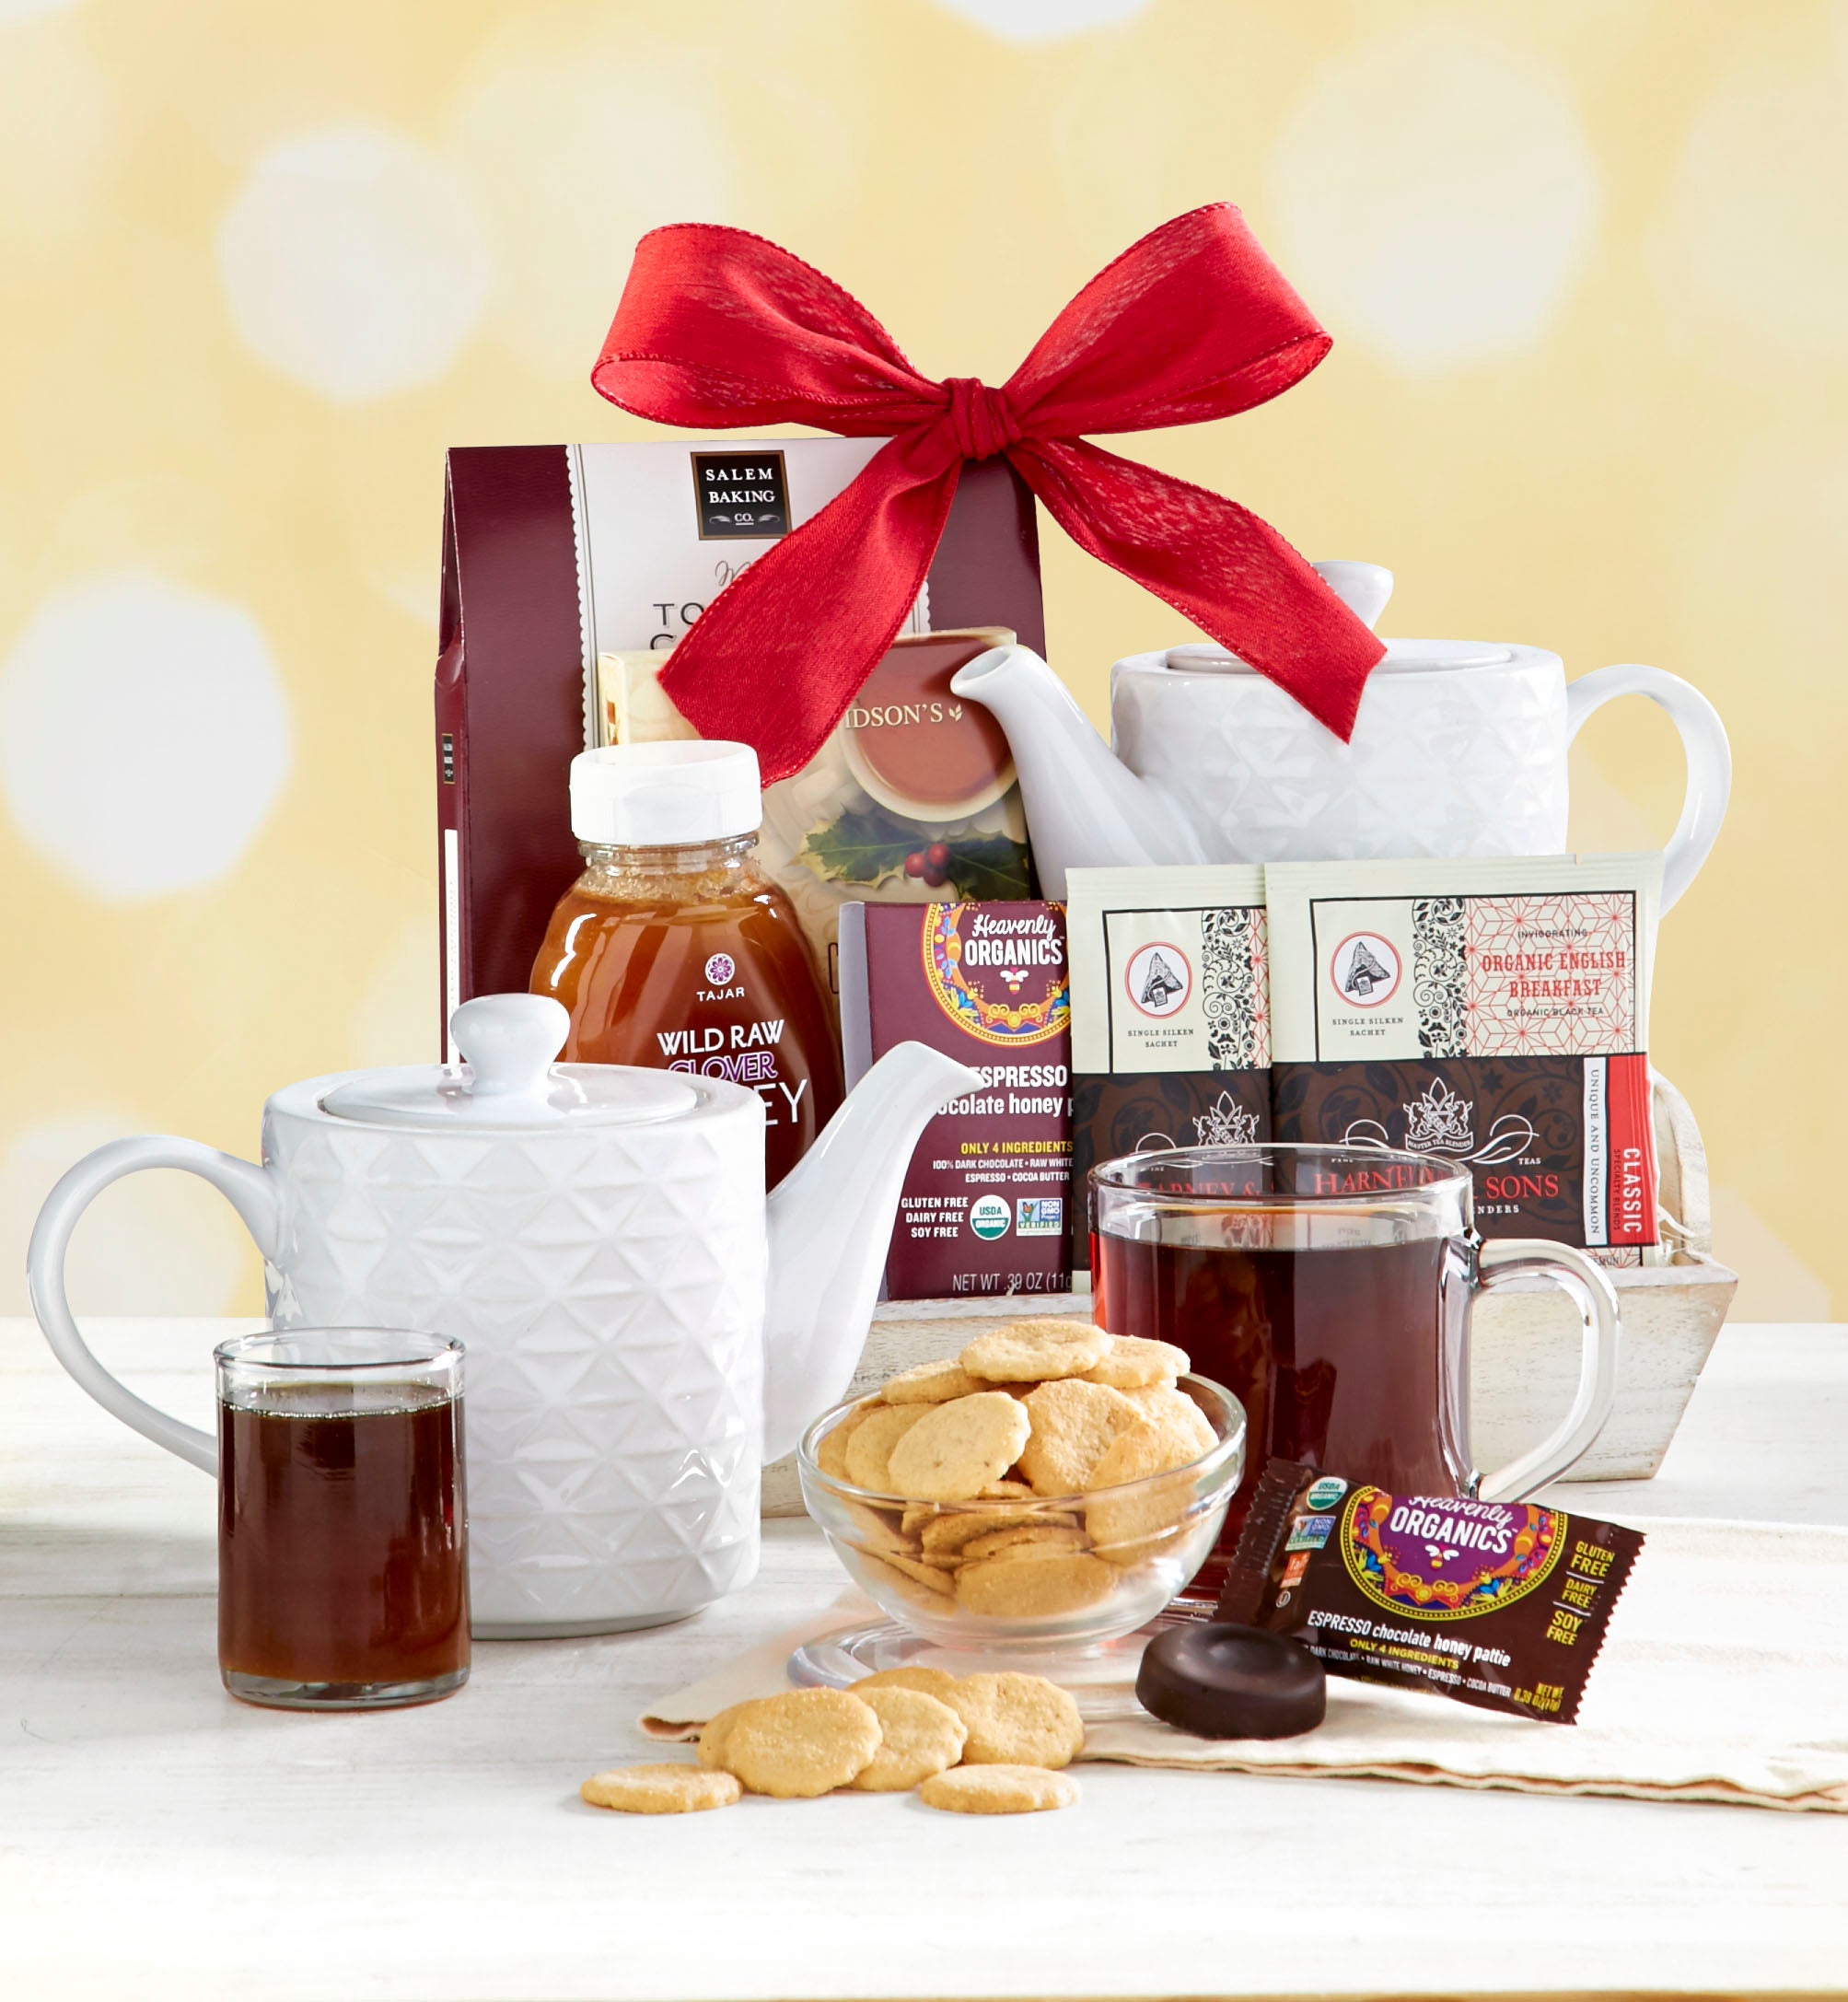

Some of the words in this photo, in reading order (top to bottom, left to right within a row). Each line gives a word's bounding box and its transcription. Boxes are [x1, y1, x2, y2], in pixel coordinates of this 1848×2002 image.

[705, 468, 773, 482] SALEM
[708, 490, 775, 504] BAKING
[734, 513, 754, 522] CO.
[971, 914, 1056, 940] Heavenly
[1517, 928, 1587, 939] INVIGORATING
[965, 938, 1063, 966] ORGANICS
[1482, 953, 1552, 972] ORGANIC
[1559, 951, 1626, 970] ENGLISH
[696, 986, 745, 1001] TAJAR
[1509, 978, 1601, 997] BREAKFAST
[1506, 1008, 1549, 1018] ORGANIC
[1552, 1007, 1584, 1017] BLACK
[1586, 1007, 1603, 1016] TEA
[657, 1028, 725, 1056] WILD
[730, 1018, 785, 1050] RAW
[968, 1065, 1067, 1088] SPRESSO
[1588, 1068, 1599, 1120] UNIQUE
[1008, 1092, 1063, 1118] honey
[960, 1142, 990, 1155] ONLY
[992, 1142, 999, 1154] 4
[1002, 1141, 1073, 1154] INGREDIENTS
[1590, 1125, 1599, 1154] AND
[933, 1159, 954, 1170] 100%
[955, 1158, 977, 1170] DARK
[978, 1158, 1023, 1170] CHOCOLATE
[1029, 1158, 1048, 1168] RAW
[1049, 1158, 1074, 1168] WHITE
[1517, 1158, 1541, 1166] TEAS
[1613, 1148, 1621, 1194] SPECIALTY
[965, 1172, 1005, 1183] ESPRESSO
[1012, 1172, 1038, 1182] COCOA
[1040, 1171, 1070, 1181] BUTTER
[1484, 1174, 1560, 1200] SONS
[1590, 1158, 1599, 1235] UNCOMMON
[1622, 1147, 1643, 1233] CLASSIC
[901, 1197, 942, 1208] GLUTEN
[943, 1196, 969, 1208] FREE
[979, 1205, 1002, 1216] USDA
[1040, 1200, 1060, 1208] NON
[905, 1212, 936, 1223] DAIRY
[939, 1211, 964, 1223] FREE
[1613, 1196, 1621, 1231] BLENDS
[911, 1227, 932, 1238] SOY
[933, 1227, 959, 1238] FREE
[952, 1274, 977, 1292] NET
[980, 1273, 1001, 1291] WT
[1026, 1272, 1043, 1290] OZ
[1389, 1506, 1513, 1554] ORGANICS
[1575, 1541, 1615, 1564] GLUTEN
[1571, 1555, 1610, 1577] FREE
[1565, 1578, 1598, 1596] DAIRY
[1561, 1590, 1593, 1609] FREE
[1552, 1611, 1583, 1634] SOY
[1308, 1610, 1372, 1636] ESPRESSO
[1372, 1623, 1431, 1647] chocolate
[1434, 1634, 1472, 1660] honey
[1473, 1645, 1512, 1668] pattie
[1546, 1625, 1577, 1647] FREE
[1350, 1638, 1377, 1652] ONLY
[1379, 1644, 1386, 1653] 4
[1389, 1646, 1459, 1670] INGREDIENTS
[1428, 1667, 1462, 1686] ESPRESSO
